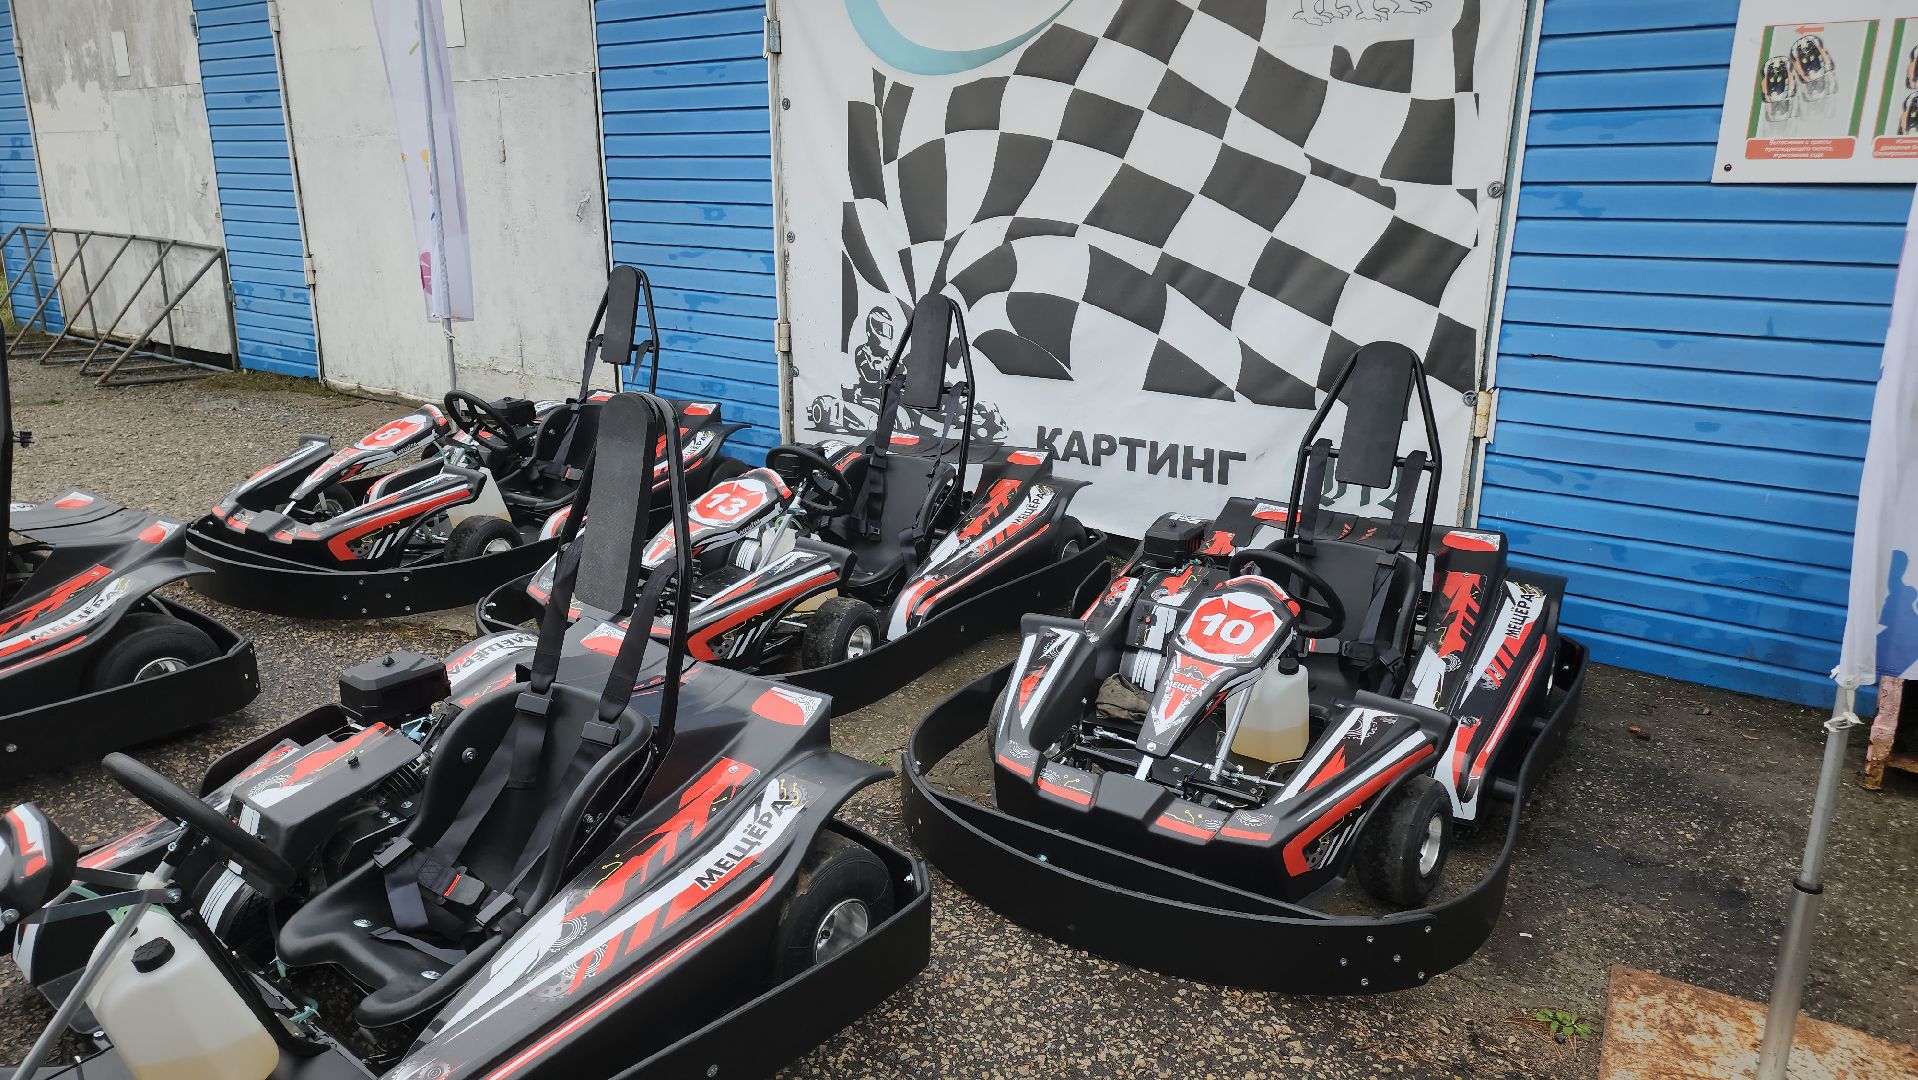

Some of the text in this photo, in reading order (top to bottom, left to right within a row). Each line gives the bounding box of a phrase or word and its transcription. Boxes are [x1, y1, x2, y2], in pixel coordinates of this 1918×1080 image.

[374, 427, 400, 440] 8
[1036, 425, 1246, 485] КАРТИНГ
[706, 492, 748, 516] 13
[1200, 612, 1255, 645] 10
[1504, 594, 1535, 639] МЕЩЁРА
[694, 800, 794, 890] МЕЩЁРА
